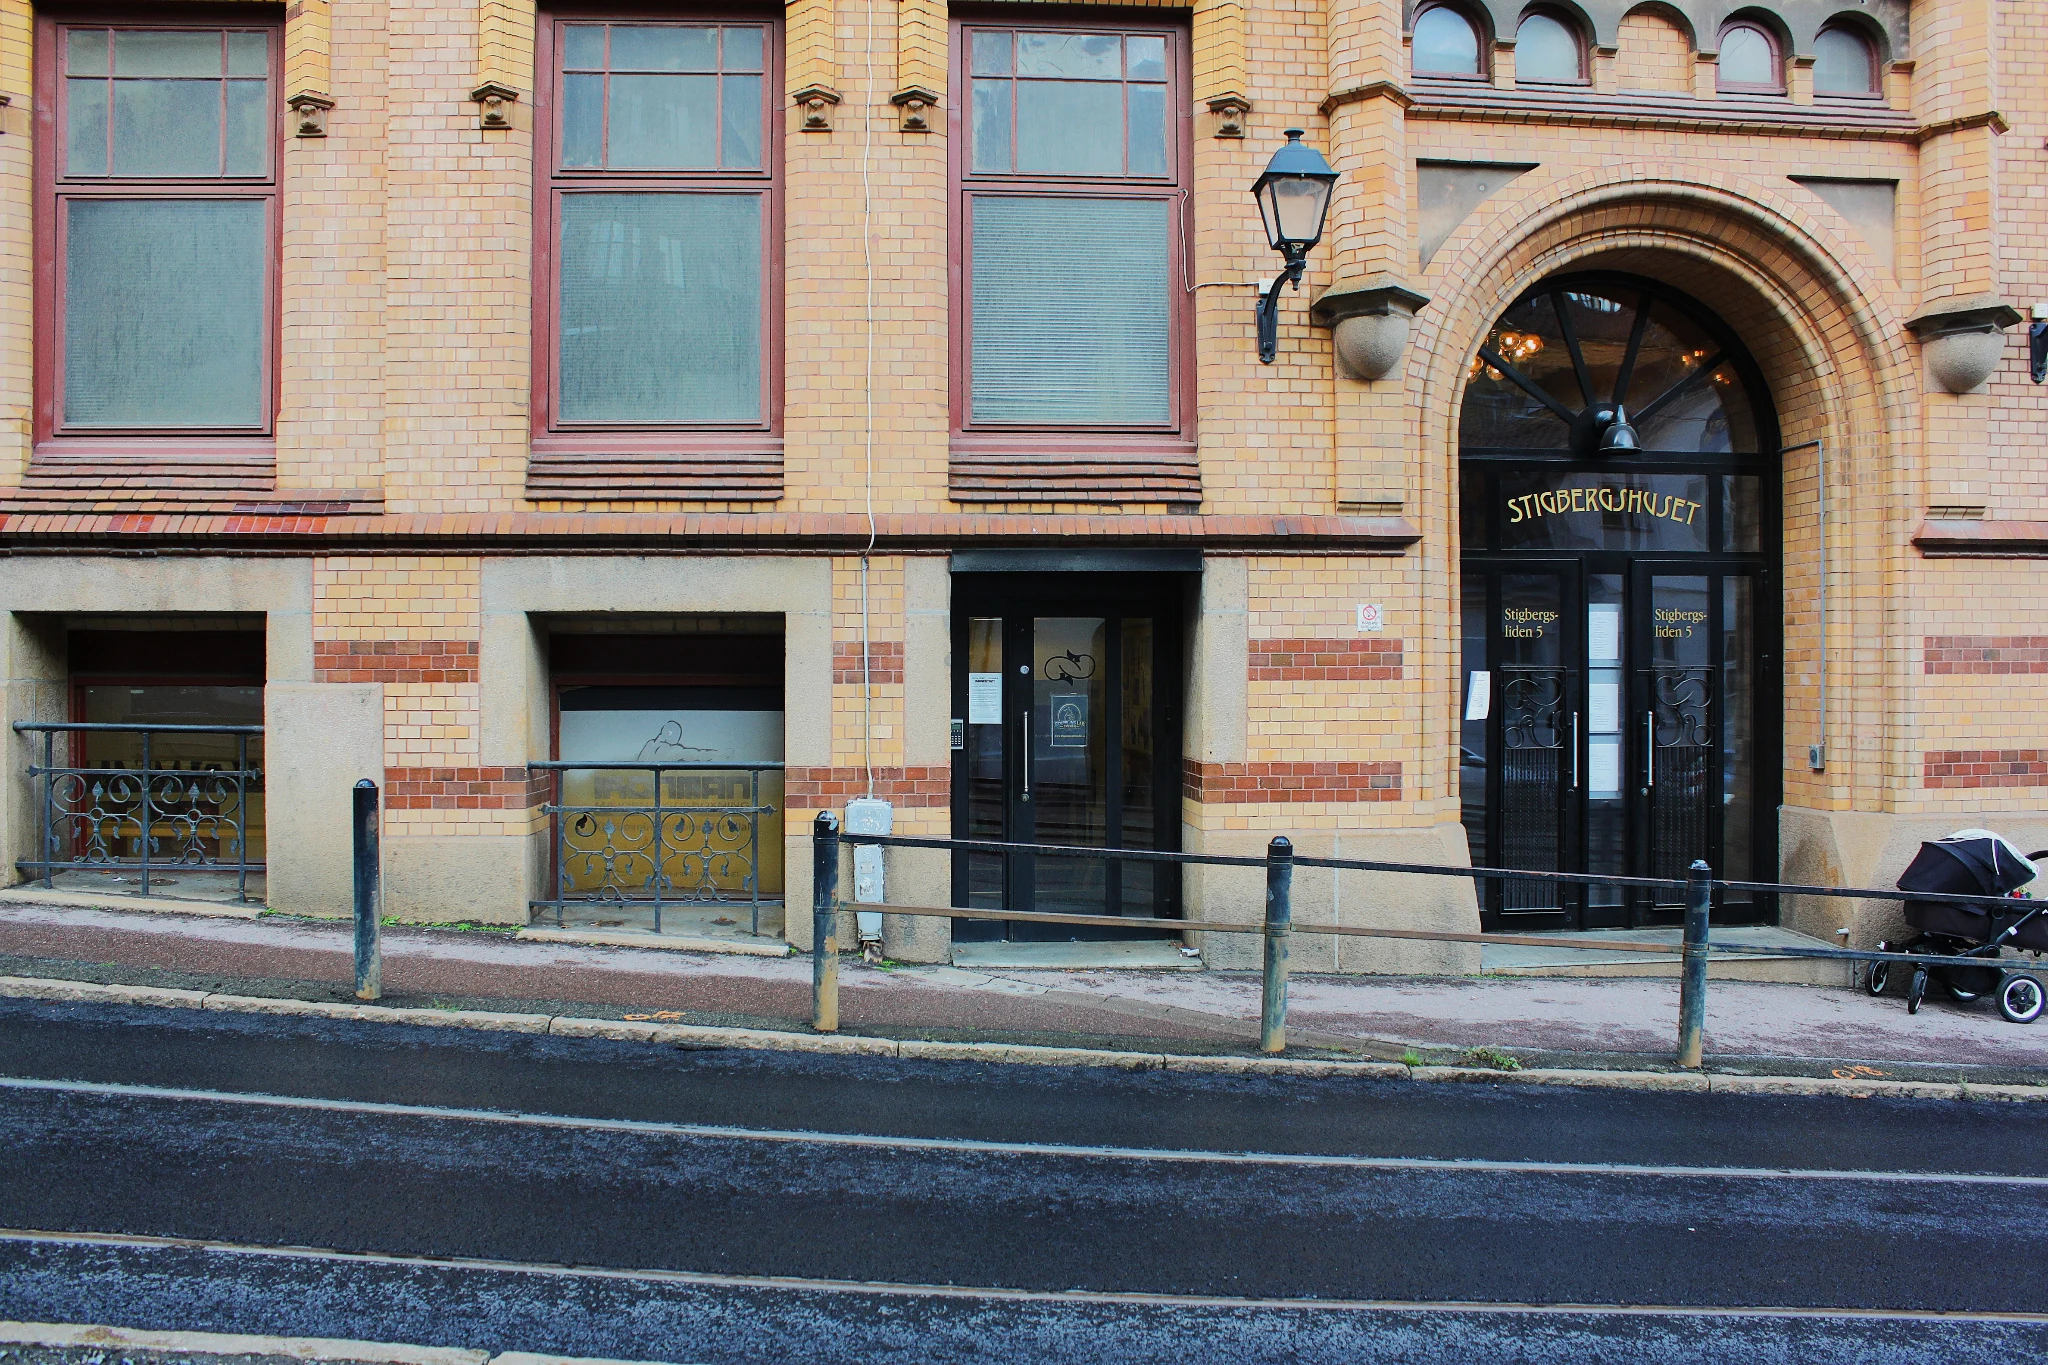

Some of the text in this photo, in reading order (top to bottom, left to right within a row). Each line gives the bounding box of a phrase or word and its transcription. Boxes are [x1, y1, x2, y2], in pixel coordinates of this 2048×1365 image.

[1507, 488, 1701, 525] STIGBERGSHUSET
[1504, 607, 1559, 624] Stigbergs-
[1654, 607, 1707, 624] Stigbergs-
[1504, 624, 1543, 639] liden 5
[1654, 624, 1692, 639] liden 5
